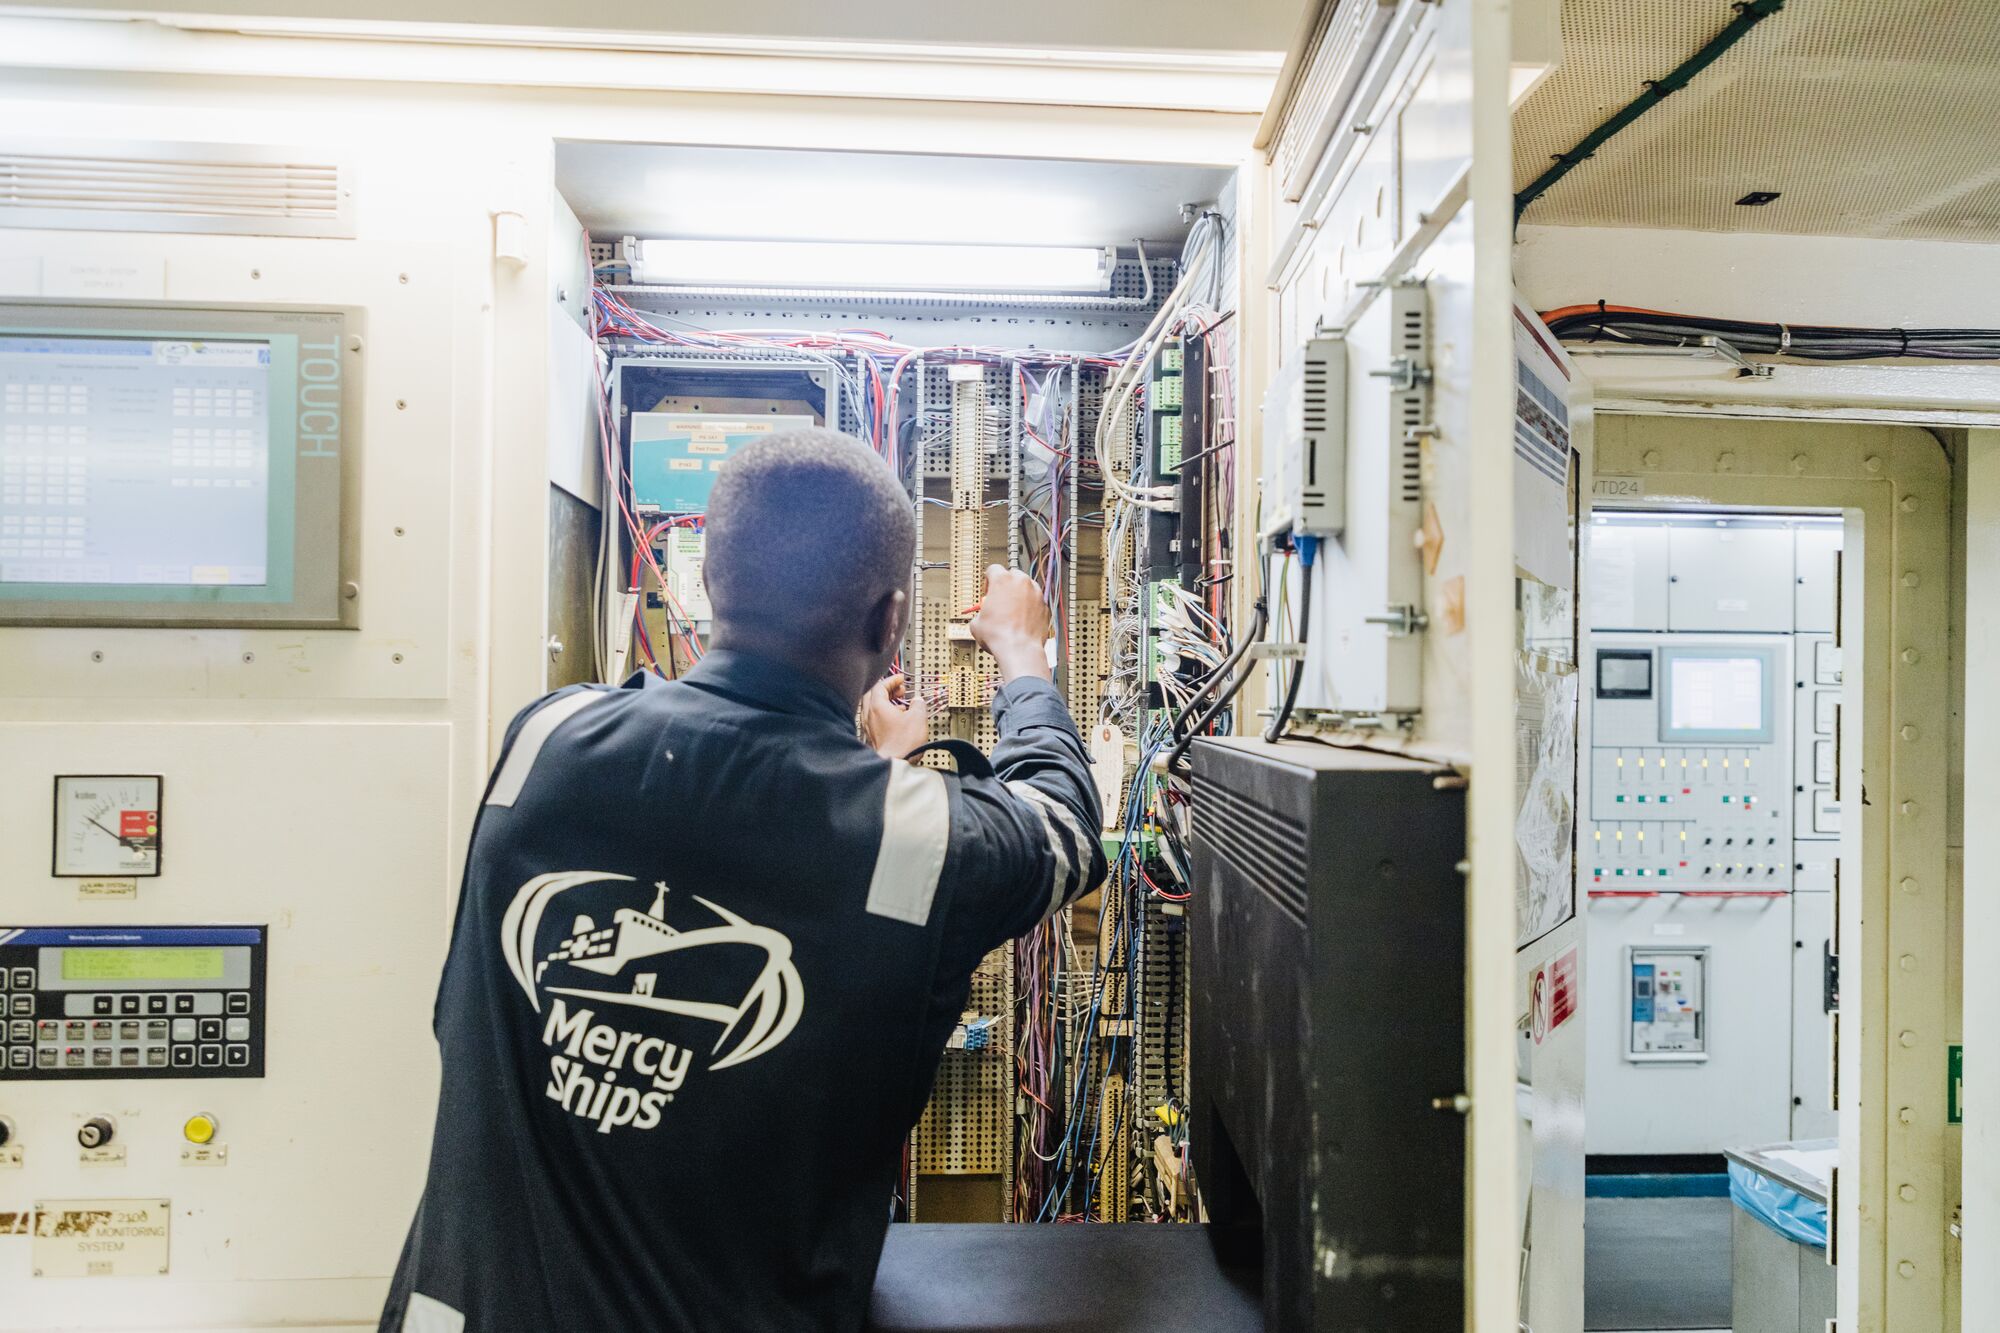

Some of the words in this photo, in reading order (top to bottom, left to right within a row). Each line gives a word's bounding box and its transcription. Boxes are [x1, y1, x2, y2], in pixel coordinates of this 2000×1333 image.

[299, 335, 341, 459] TOUCH
[97, 1001, 108, 1009] S1
[152, 1000, 163, 1008] S3
[179, 1000, 190, 1008] S4
[541, 998, 694, 1092] Mercy
[545, 1054, 669, 1134] Ships
[96, 1226, 165, 1238] MONITORING
[77, 1241, 125, 1253] SYSTEM
